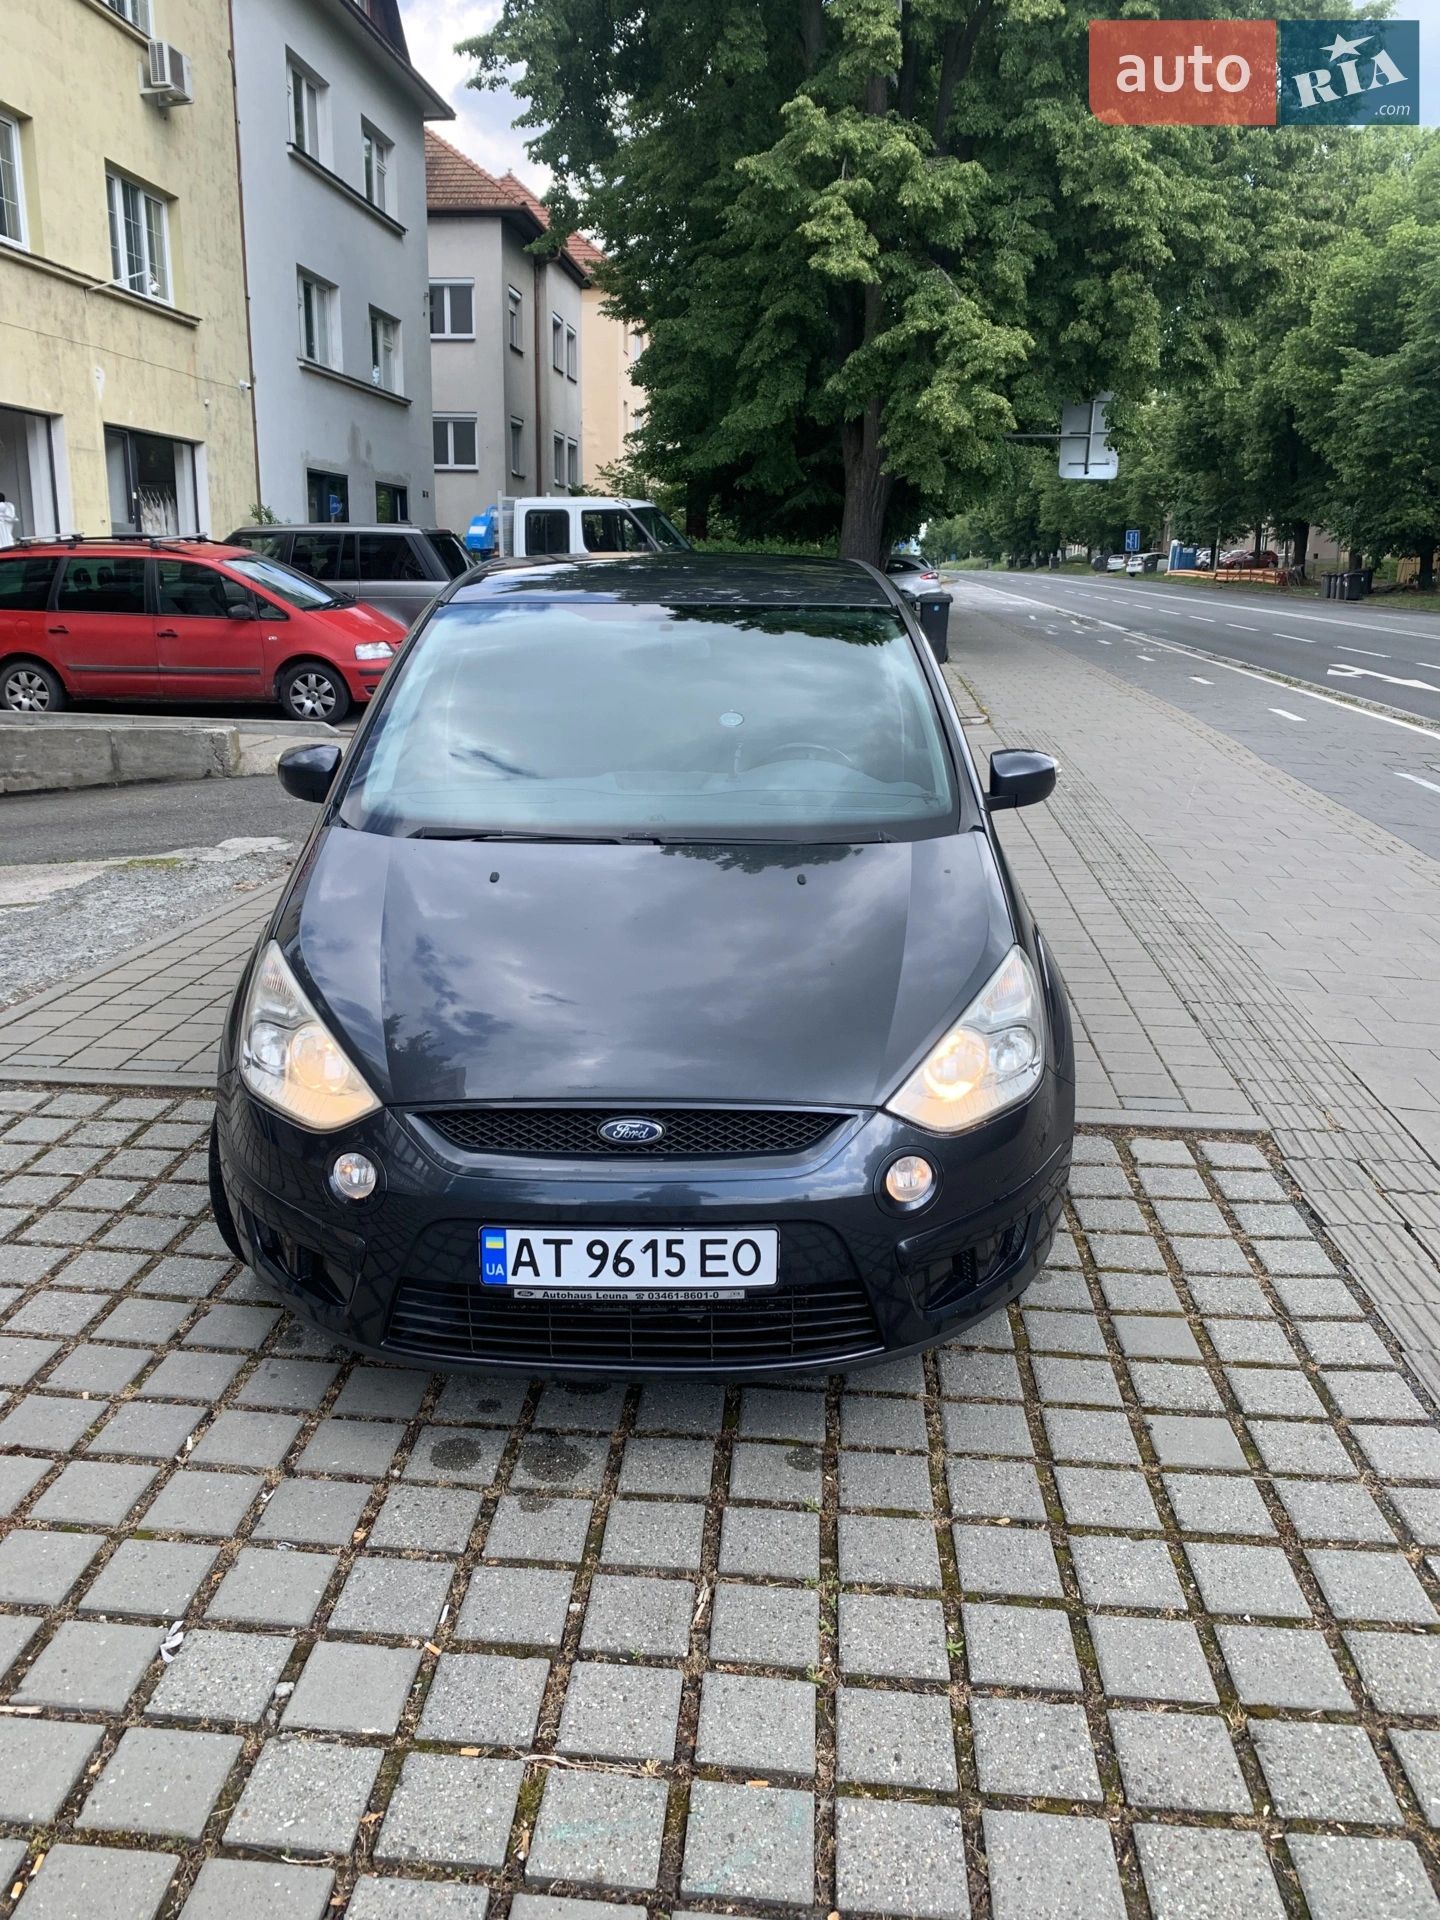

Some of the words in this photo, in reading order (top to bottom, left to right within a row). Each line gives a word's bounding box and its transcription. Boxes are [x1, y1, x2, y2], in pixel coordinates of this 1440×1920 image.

[612, 1123, 650, 1139] Ford
[511, 1238, 573, 1278] AT
[586, 1238, 686, 1278] 9615
[699, 1238, 762, 1277] EO
[486, 1262, 505, 1276] UA
[541, 1290, 592, 1300] Autohaus
[595, 1290, 629, 1300] Leuna
[647, 1290, 719, 1300] 03461-8601-0
